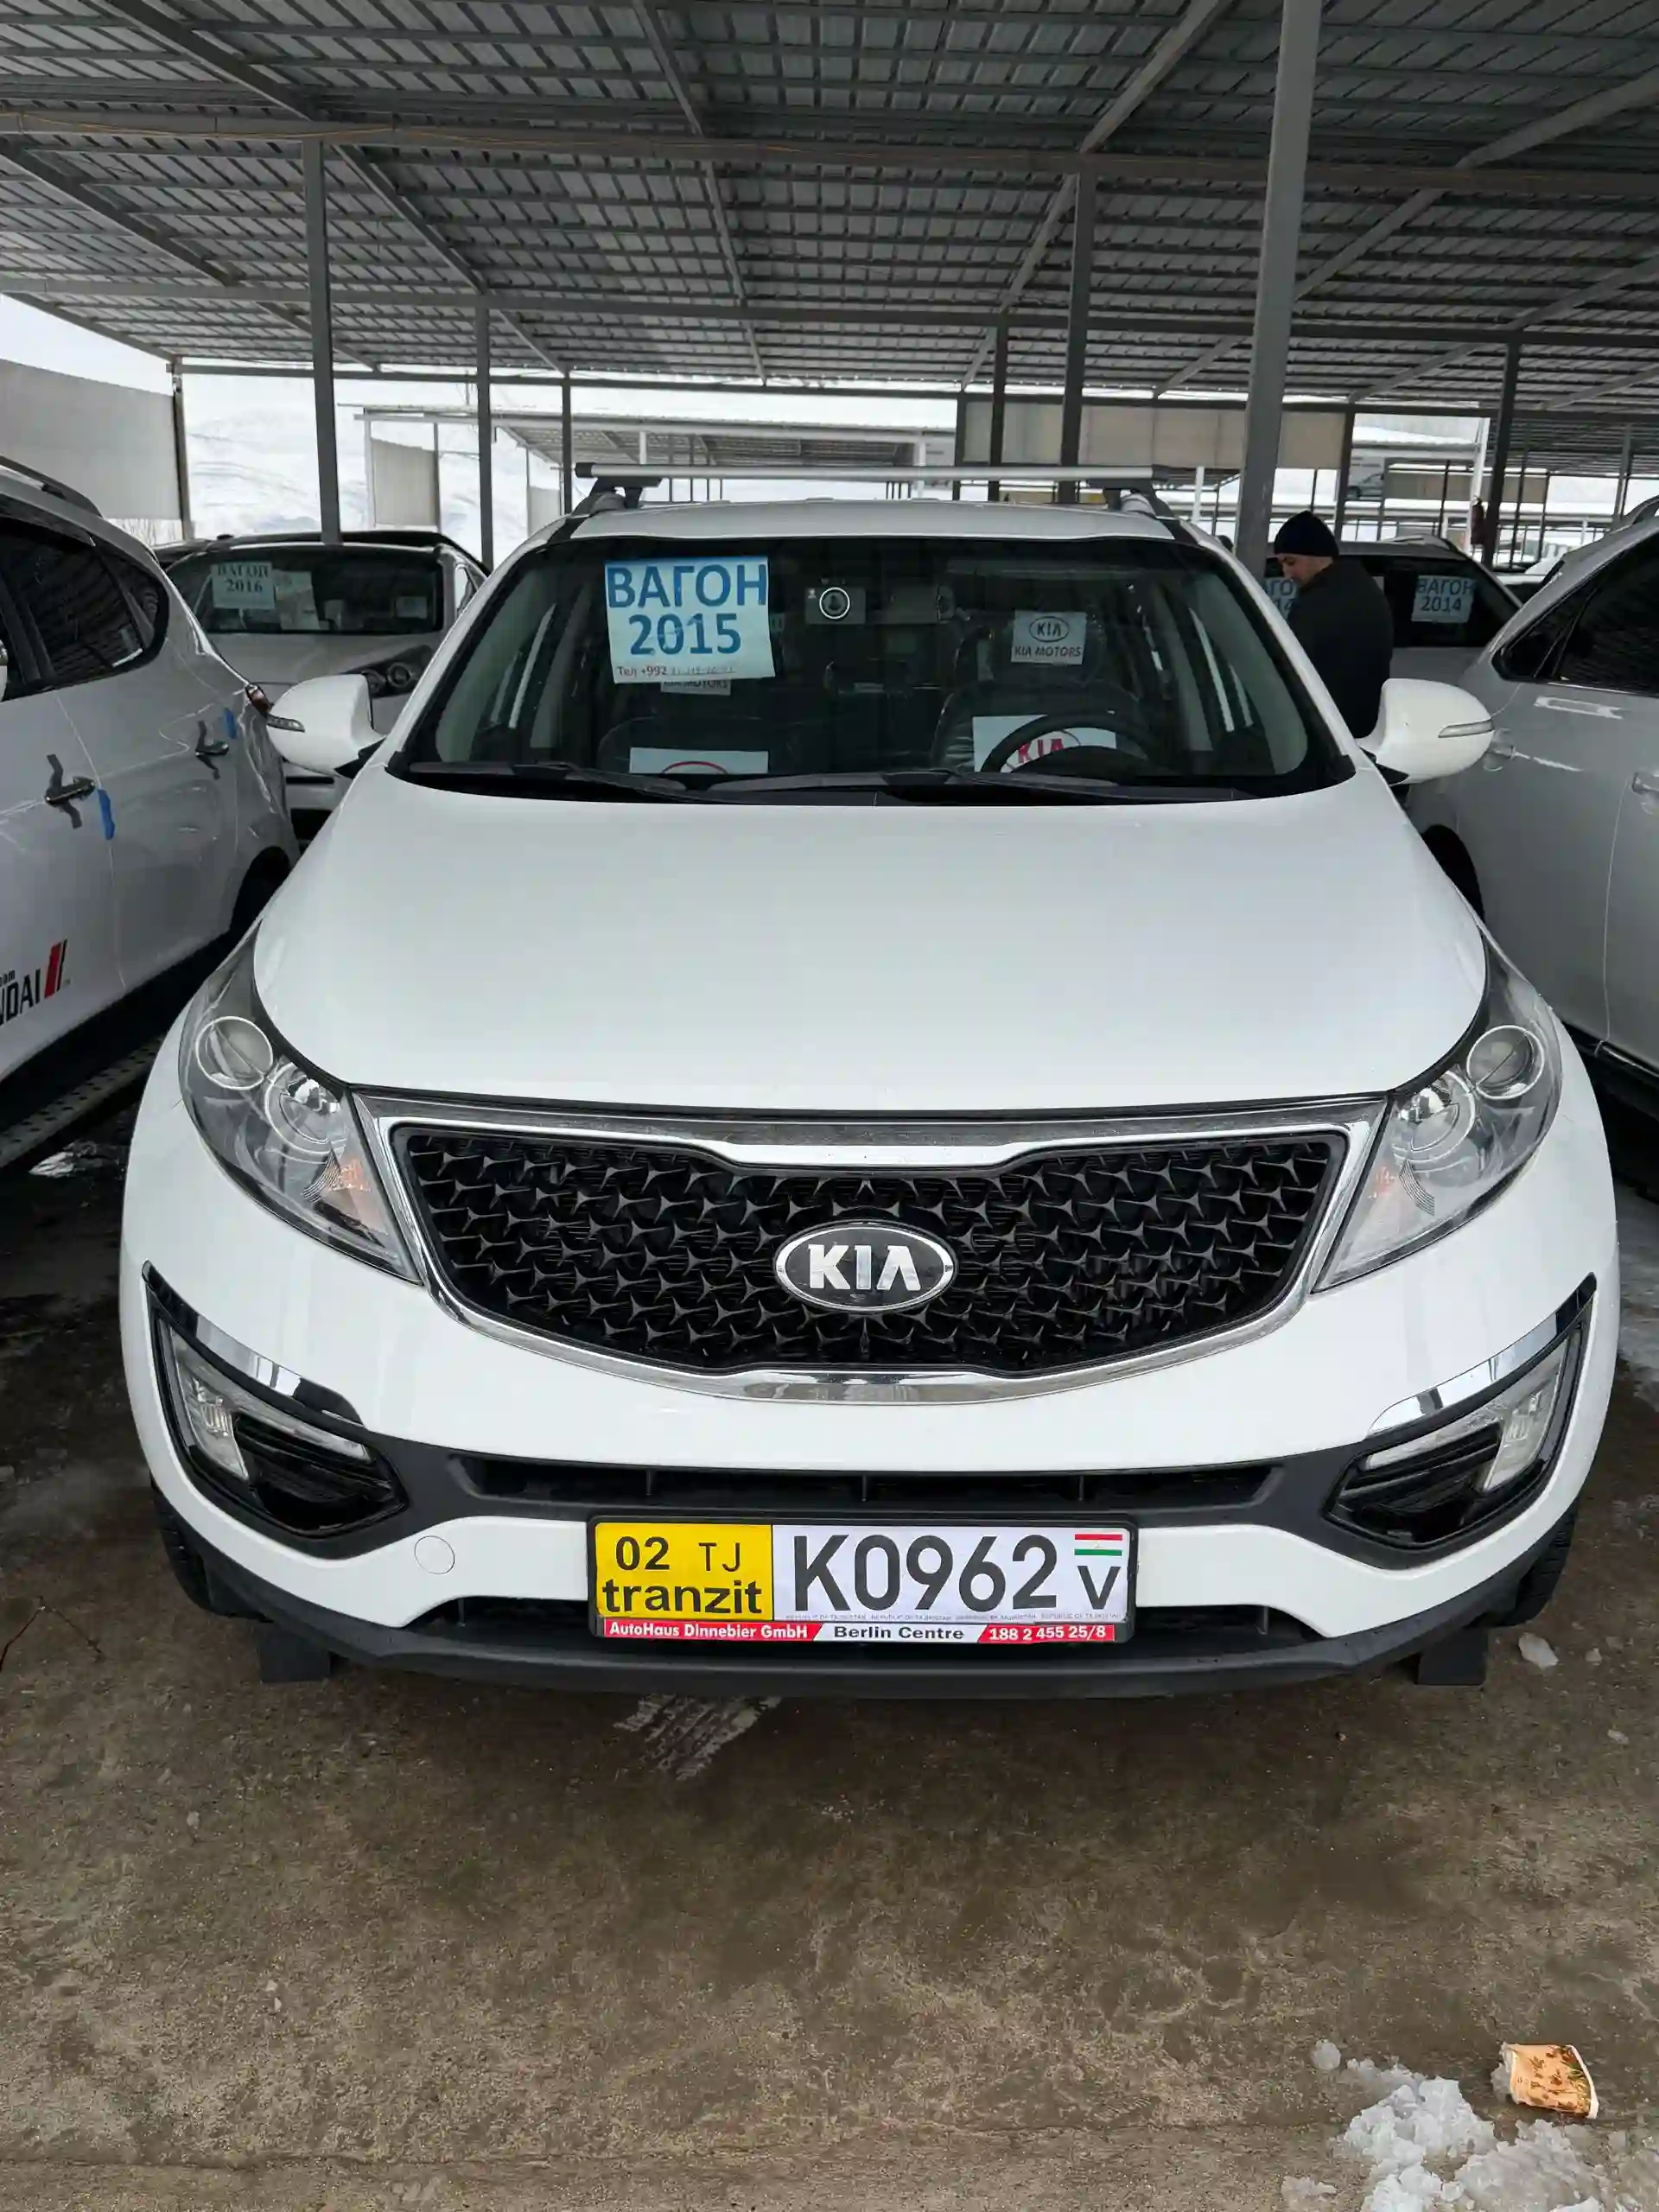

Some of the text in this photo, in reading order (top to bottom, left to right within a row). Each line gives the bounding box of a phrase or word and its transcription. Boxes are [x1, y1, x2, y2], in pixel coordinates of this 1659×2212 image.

[224, 578, 263, 593] 2016
[606, 563, 767, 608] ВАГОН
[1421, 596, 1462, 612] 2014
[628, 613, 741, 656] 2015
[1037, 623, 1062, 637] KIA
[1014, 645, 1083, 658] KIA MOTORS
[808, 1243, 922, 1291] KIA
[615, 1535, 741, 1573] 02 TJ
[793, 1534, 1058, 1612] K0962
[602, 1579, 762, 1614] tranzit
[1077, 1565, 1122, 1611] V
[609, 1621, 808, 1639] AutoHaus Dinnebier GmbH
[834, 1625, 964, 1639] Berlin Centre
[990, 1625, 1106, 1641] 188 2 455 25/8
